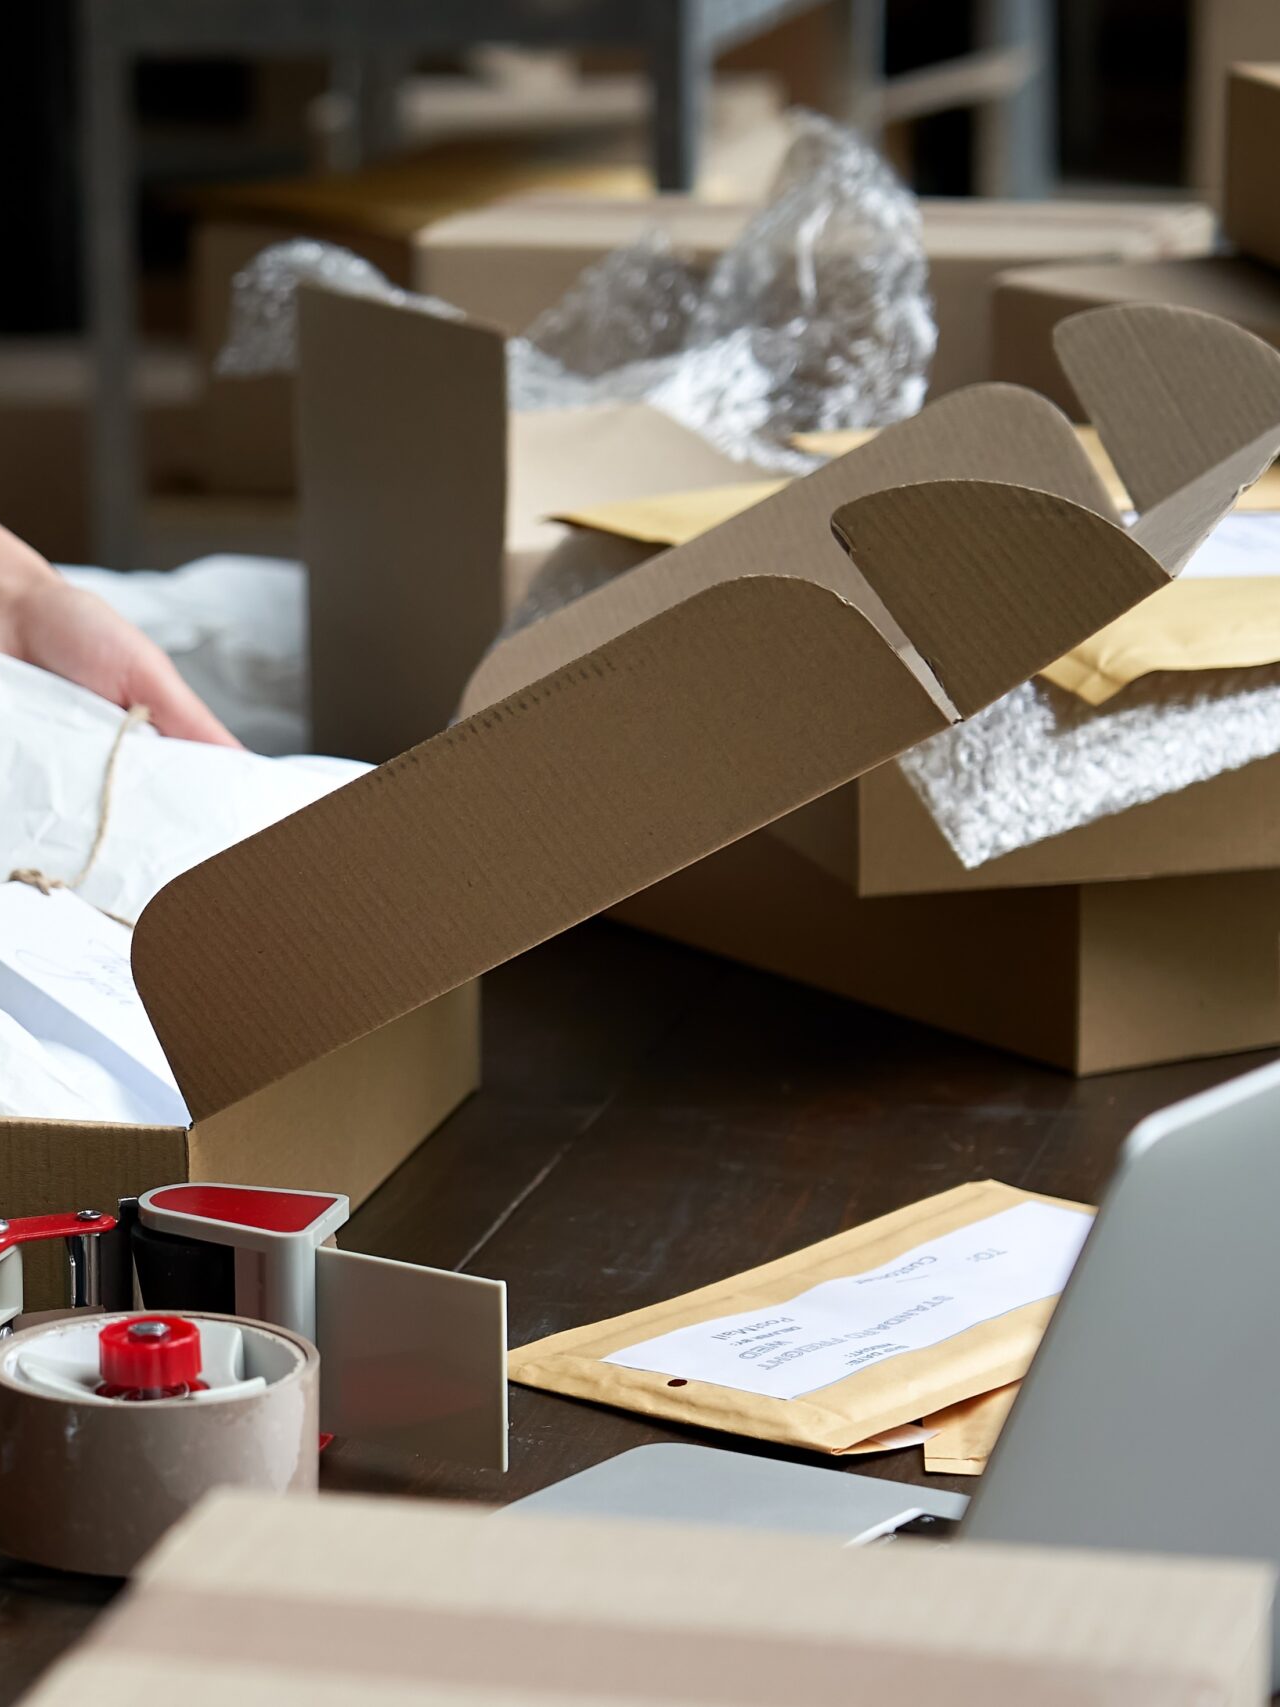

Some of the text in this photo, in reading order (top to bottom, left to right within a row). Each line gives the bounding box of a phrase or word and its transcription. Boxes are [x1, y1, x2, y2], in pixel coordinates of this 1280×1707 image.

[738, 1341, 793, 1361] WED
[757, 1295, 954, 1371] STANDARD FREIGHT
